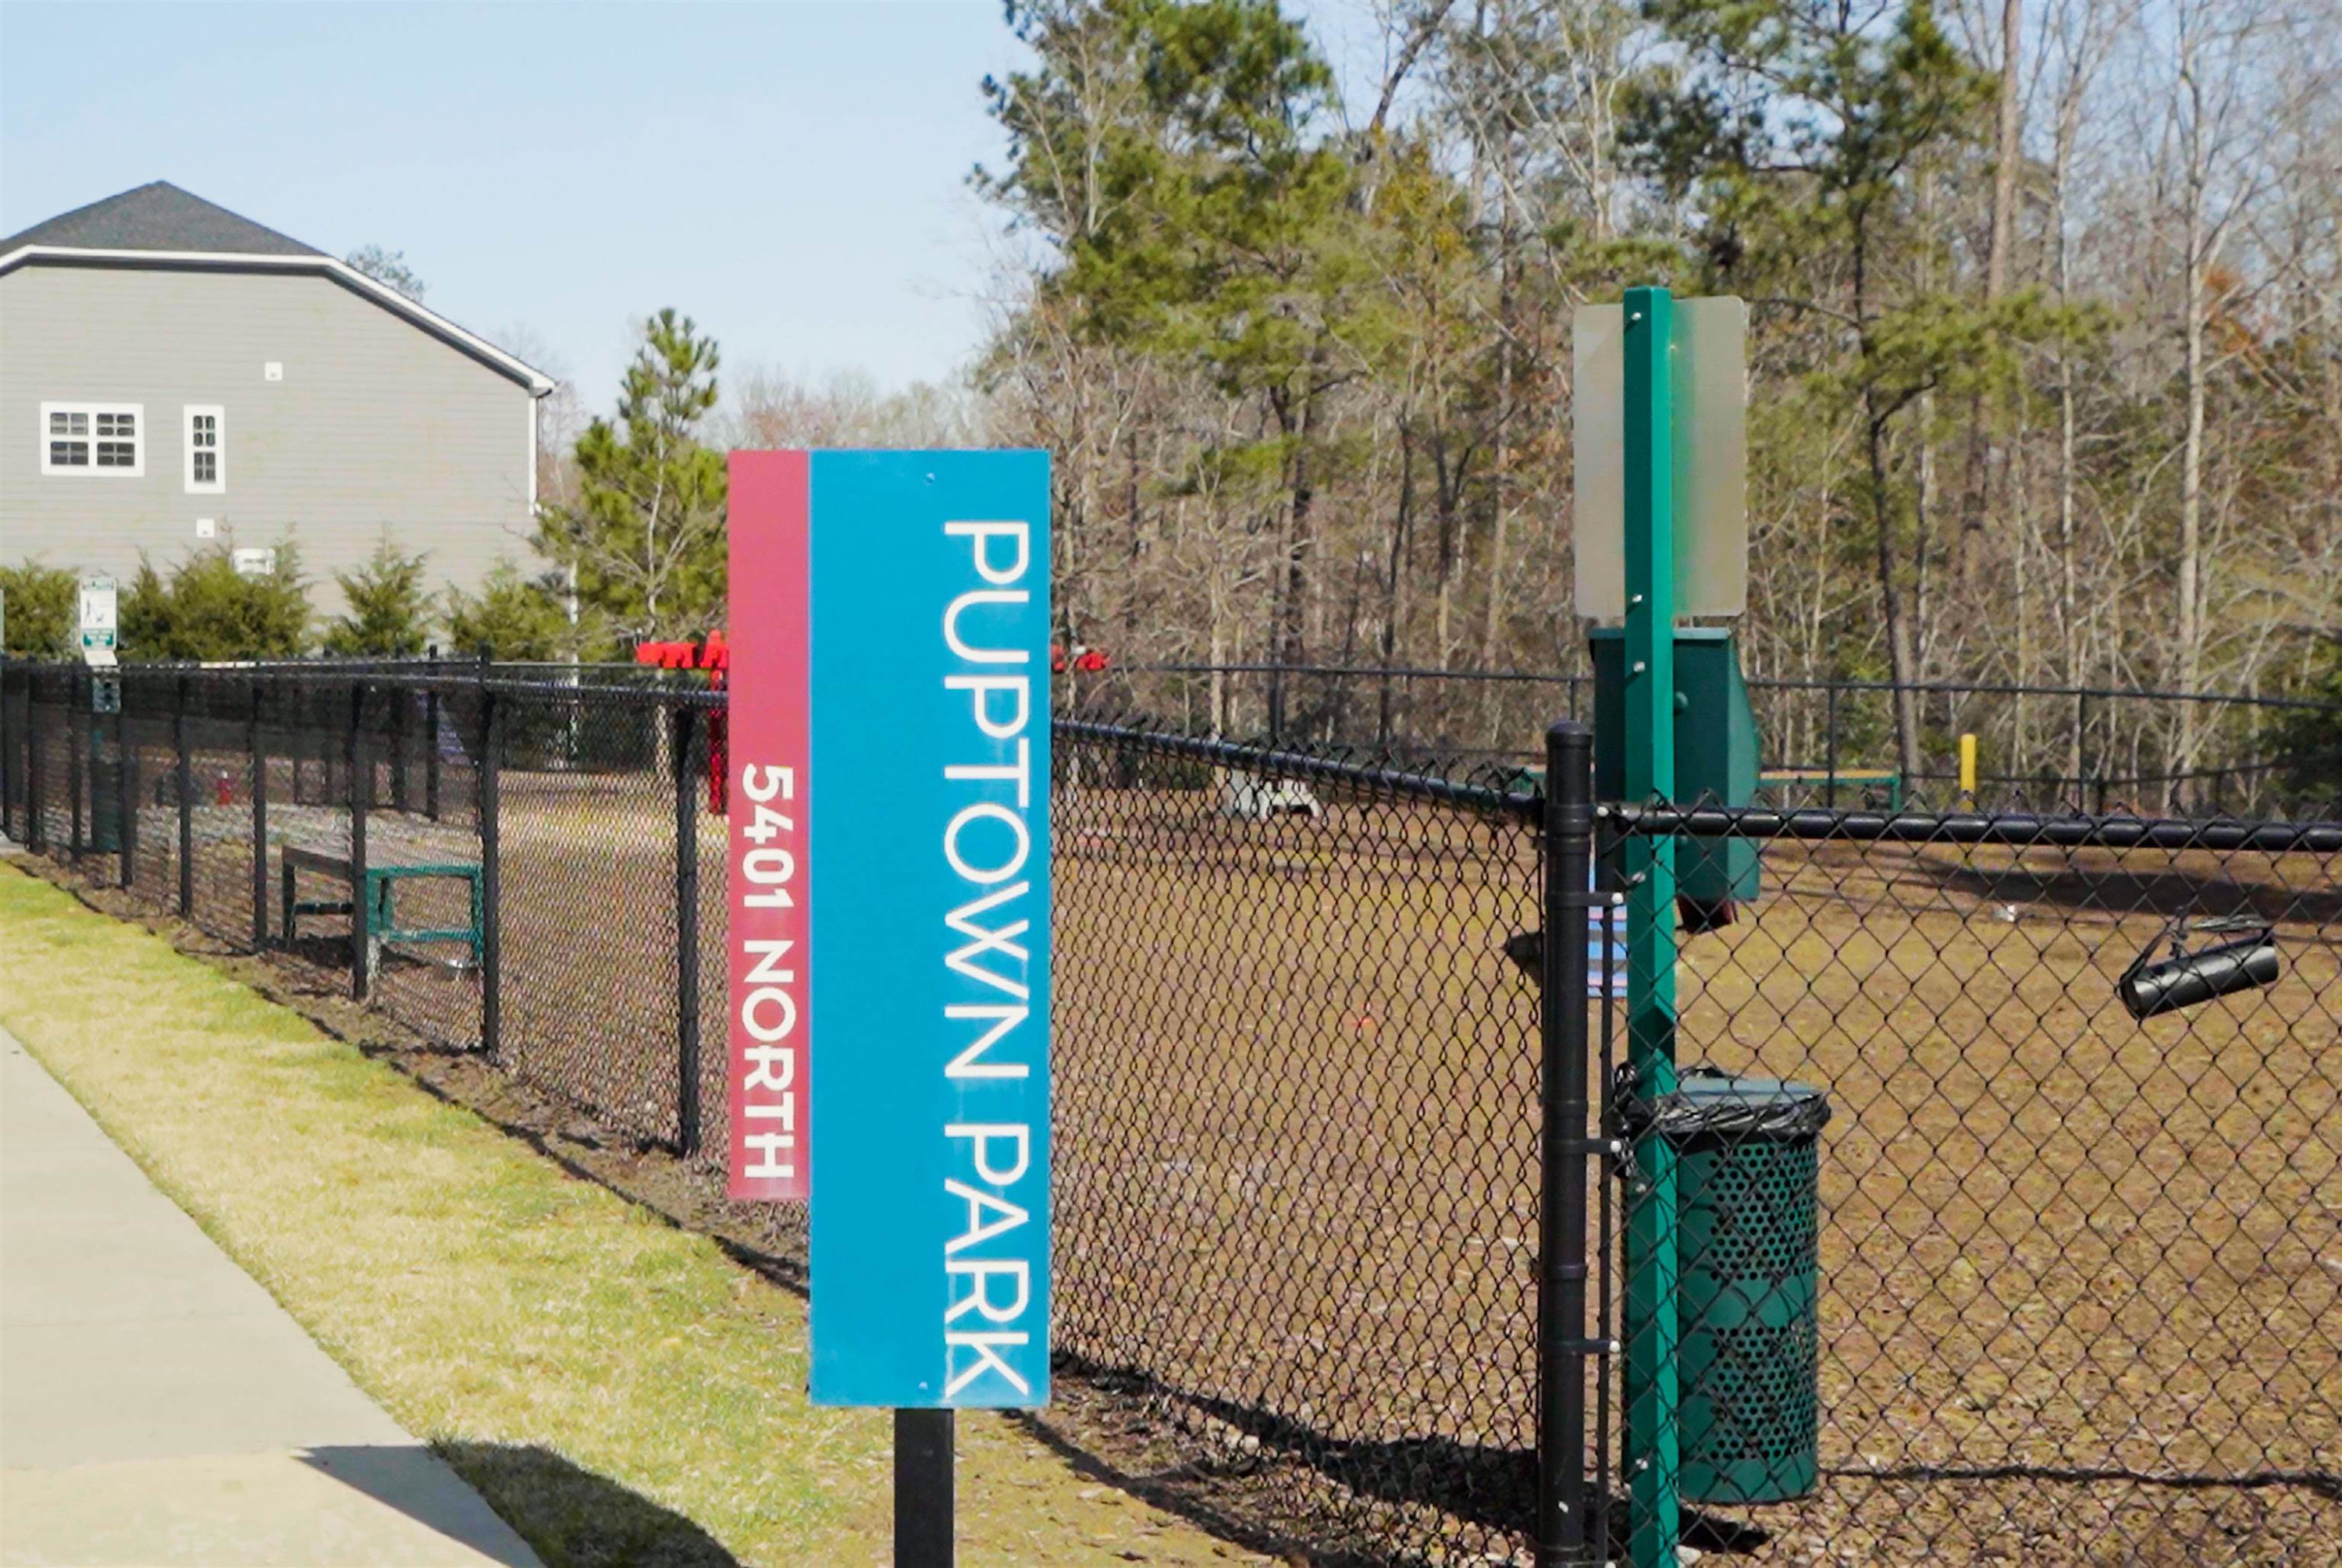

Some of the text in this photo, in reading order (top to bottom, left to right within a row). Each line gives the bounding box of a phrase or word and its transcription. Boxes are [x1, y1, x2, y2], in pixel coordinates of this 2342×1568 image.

[741, 763, 796, 1179] 5401 NORTH
[944, 521, 1030, 1399] PUPTOWN PARK
